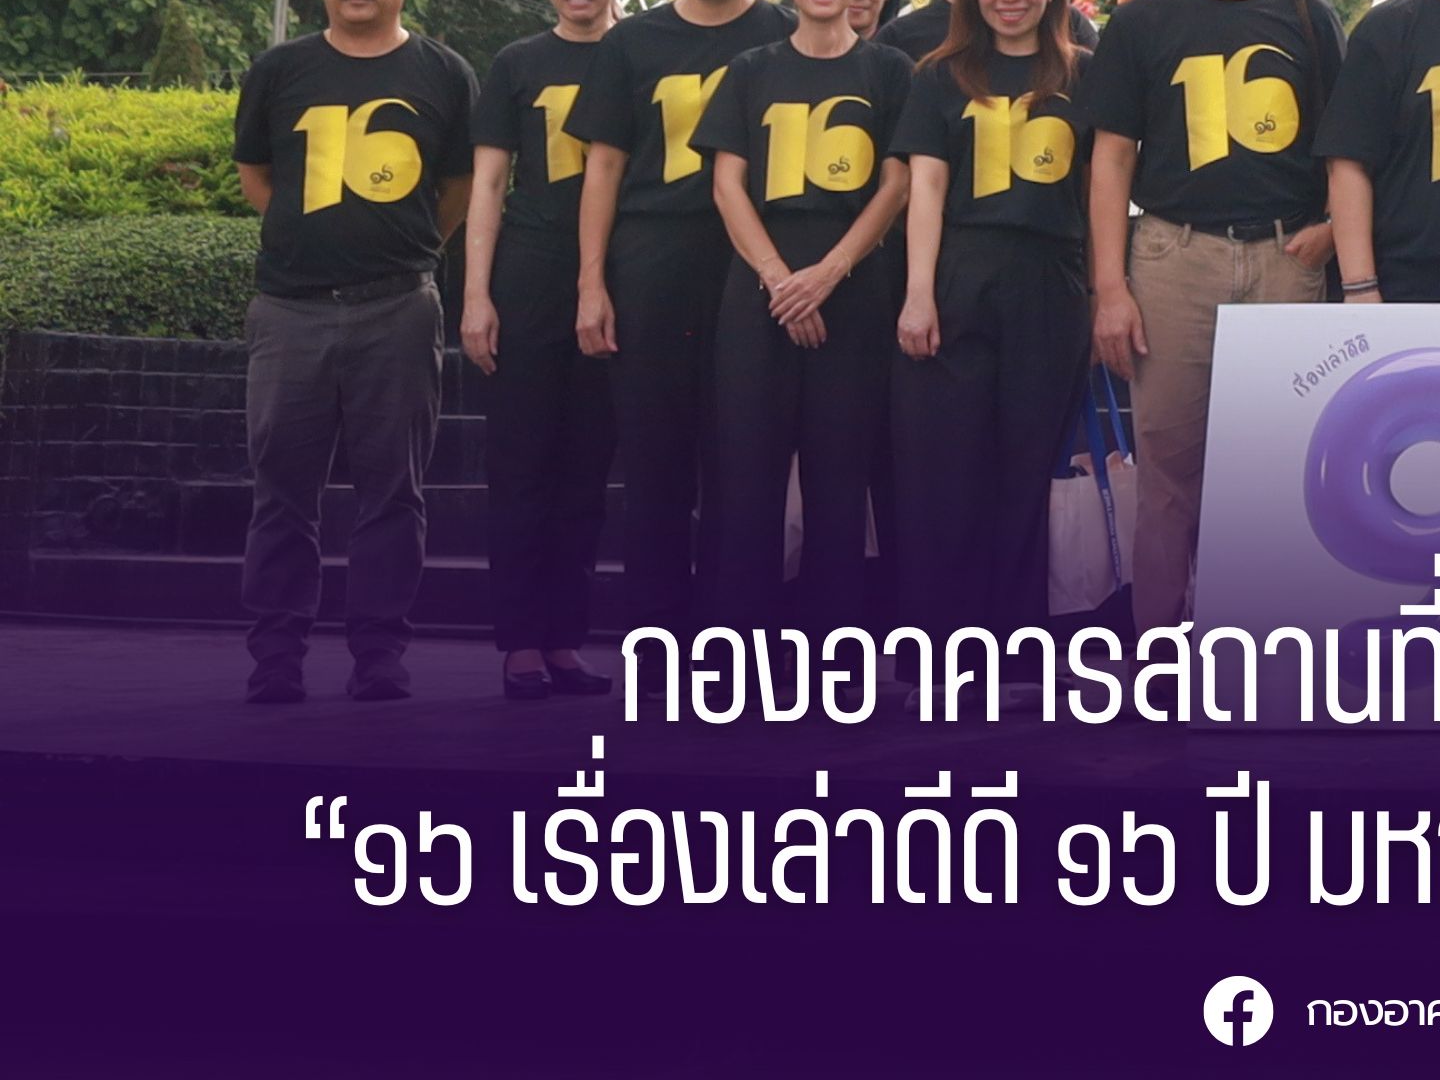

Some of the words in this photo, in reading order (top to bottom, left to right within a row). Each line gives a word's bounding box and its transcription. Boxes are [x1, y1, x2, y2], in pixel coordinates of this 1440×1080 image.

[293, 98, 422, 215] 16
[533, 84, 590, 183] 1
[761, 95, 875, 202] 16
[962, 91, 1075, 199] 16
[1171, 43, 1300, 172] 16
